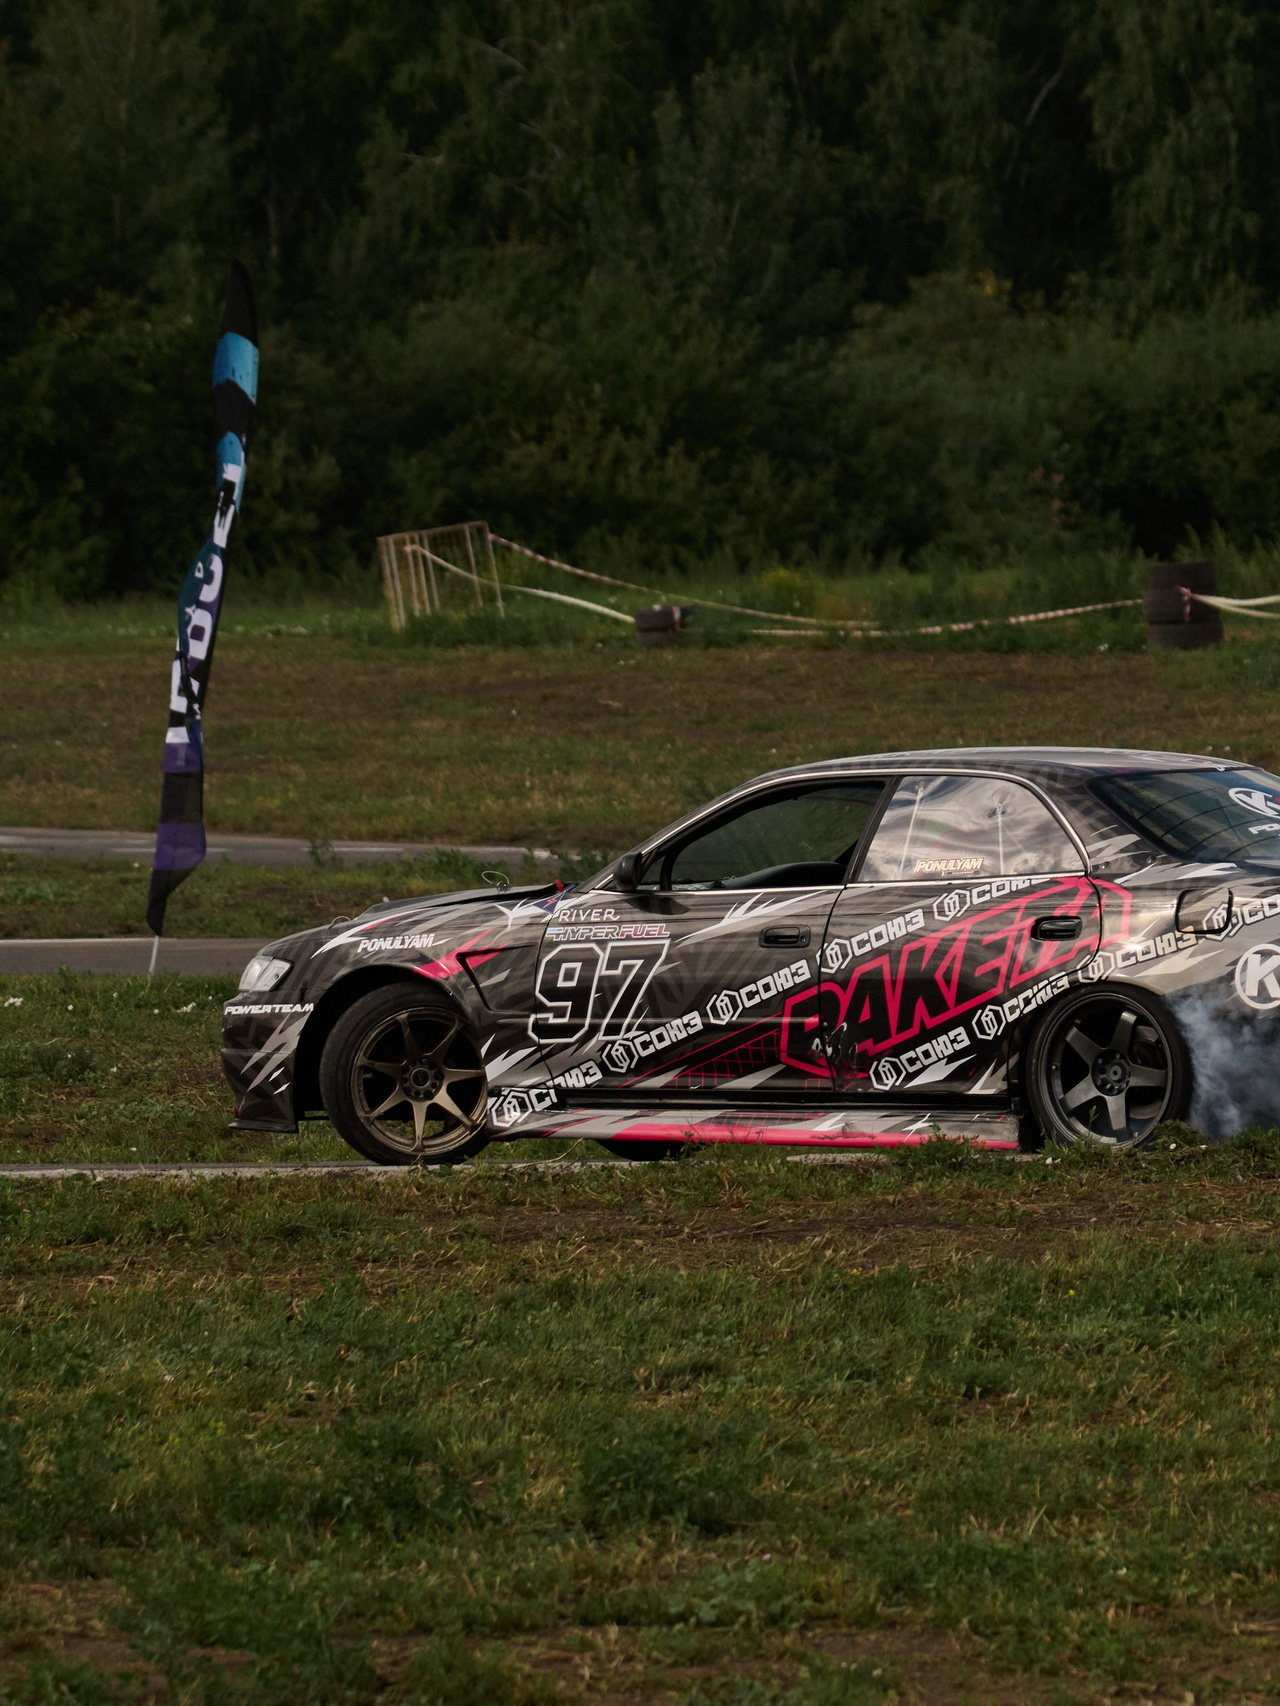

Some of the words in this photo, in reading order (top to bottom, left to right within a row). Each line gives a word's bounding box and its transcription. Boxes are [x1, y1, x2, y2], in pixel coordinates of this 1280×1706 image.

[914, 857, 984, 873] PONULYAM
[558, 908, 620, 922] RIVER
[850, 908, 925, 957] СОЮЗ
[356, 933, 435, 953] PONULYAM
[1116, 925, 1198, 968] СОЮЗ
[528, 939, 670, 1043] 97
[740, 958, 811, 1009] СОЮЗ
[1002, 971, 1070, 1023] СОЮЗ
[637, 1010, 704, 1058] СОЮЗ
[900, 1026, 971, 1073] СОЮЗ
